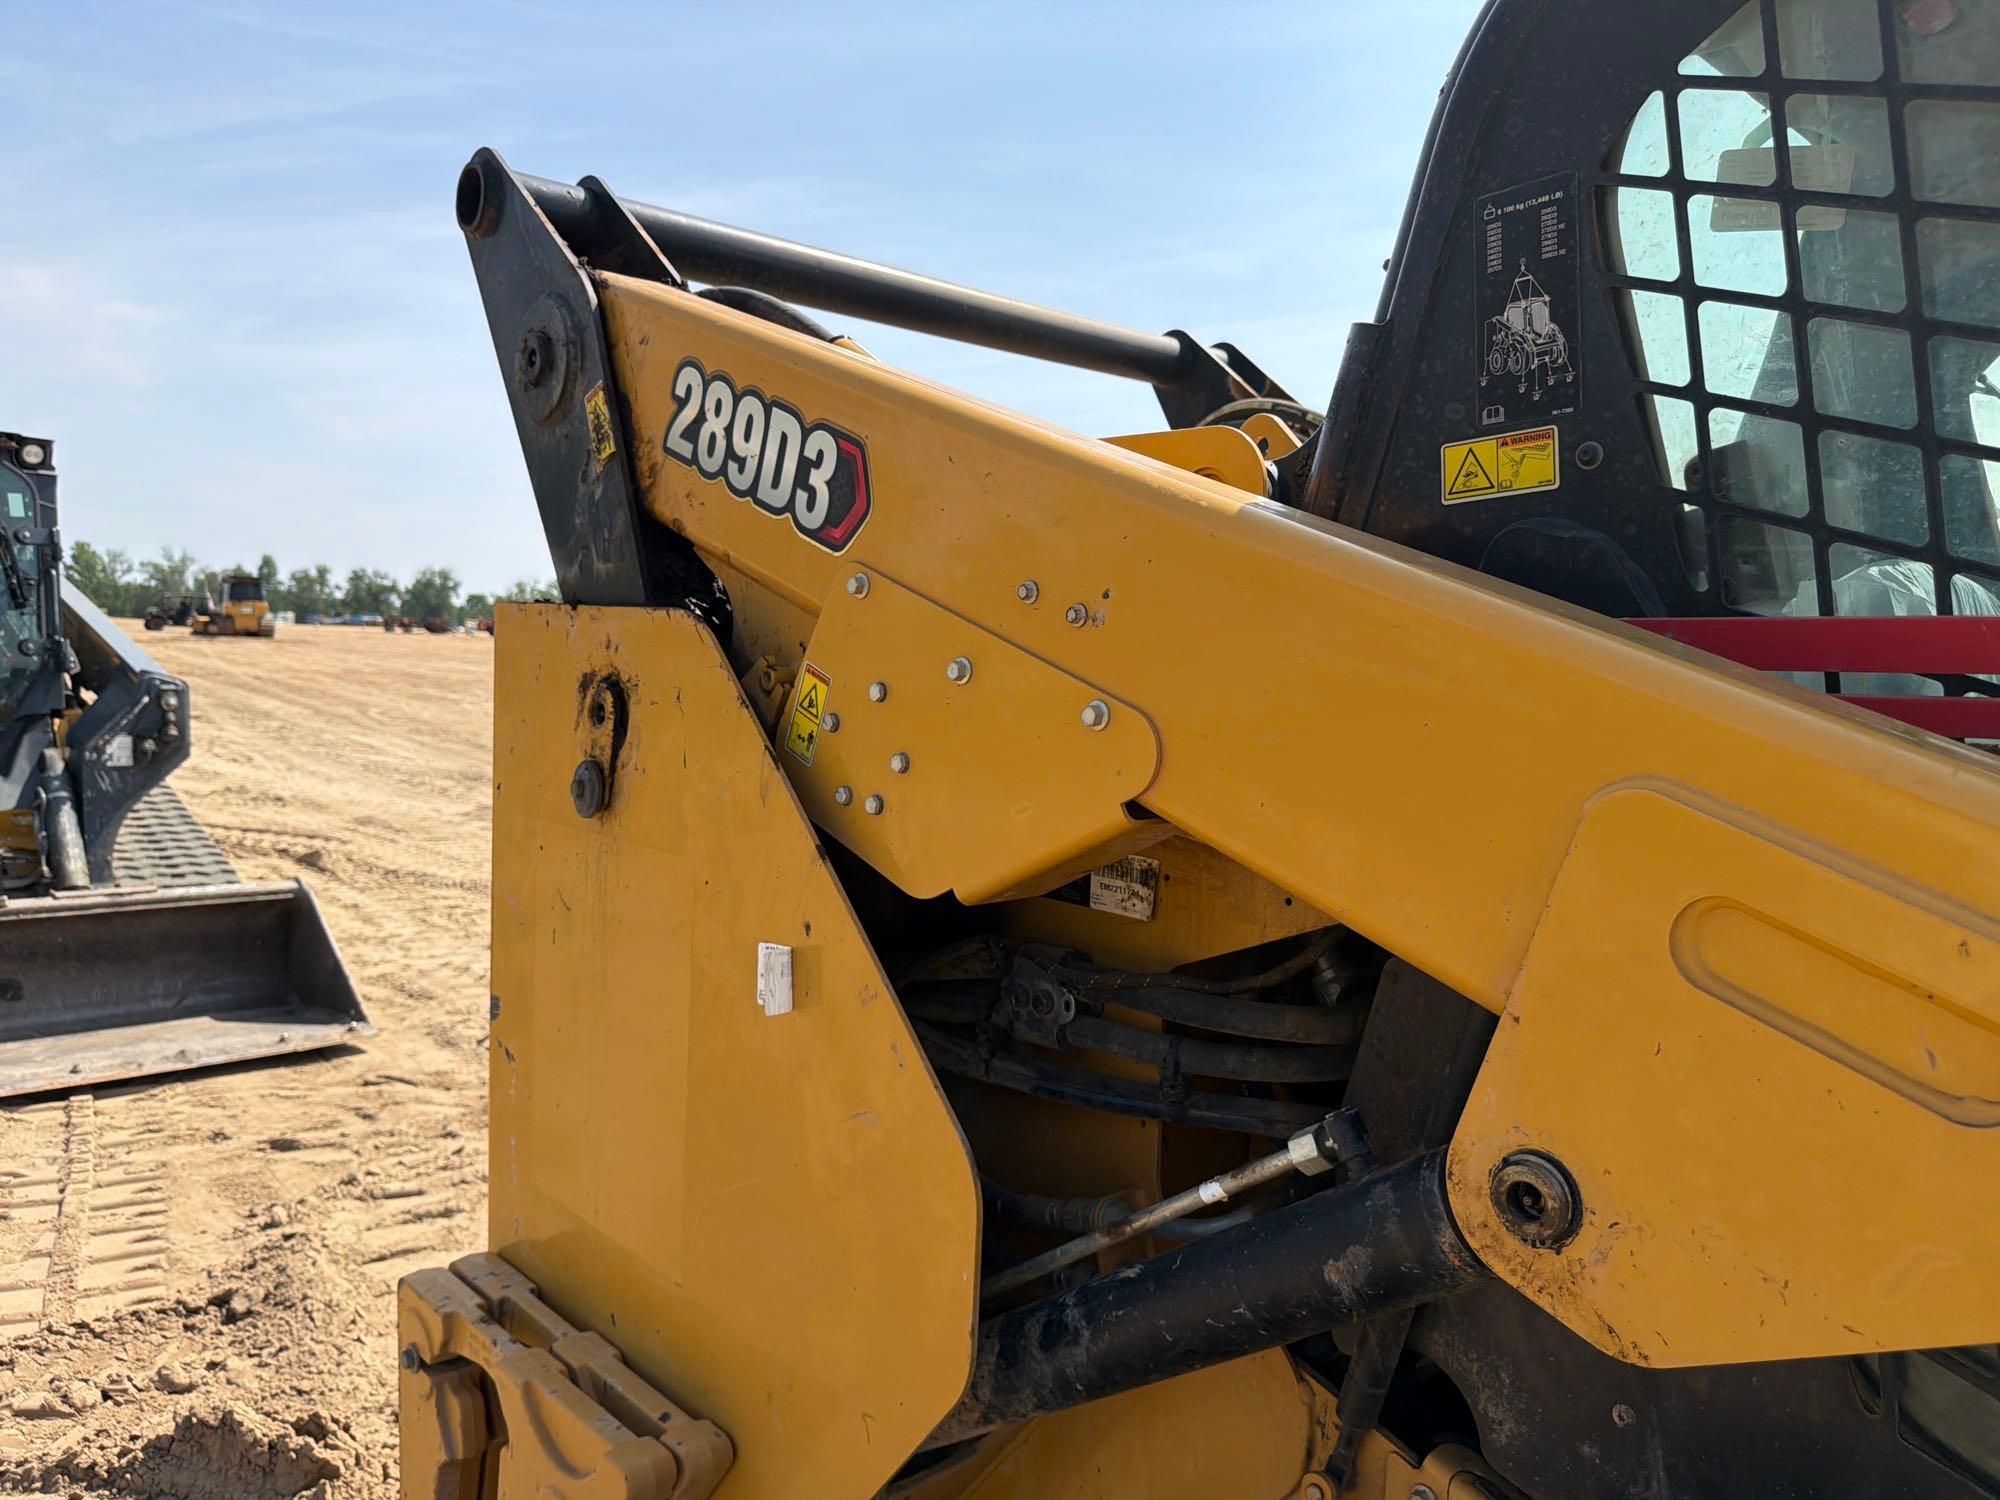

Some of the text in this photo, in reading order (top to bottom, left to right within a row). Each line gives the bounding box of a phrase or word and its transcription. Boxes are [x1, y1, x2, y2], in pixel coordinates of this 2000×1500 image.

[1503, 205, 1515, 213] 100
[1516, 202, 1525, 211] kg
[1510, 431, 1551, 445] WARNING
[666, 366, 838, 530] 289D3
